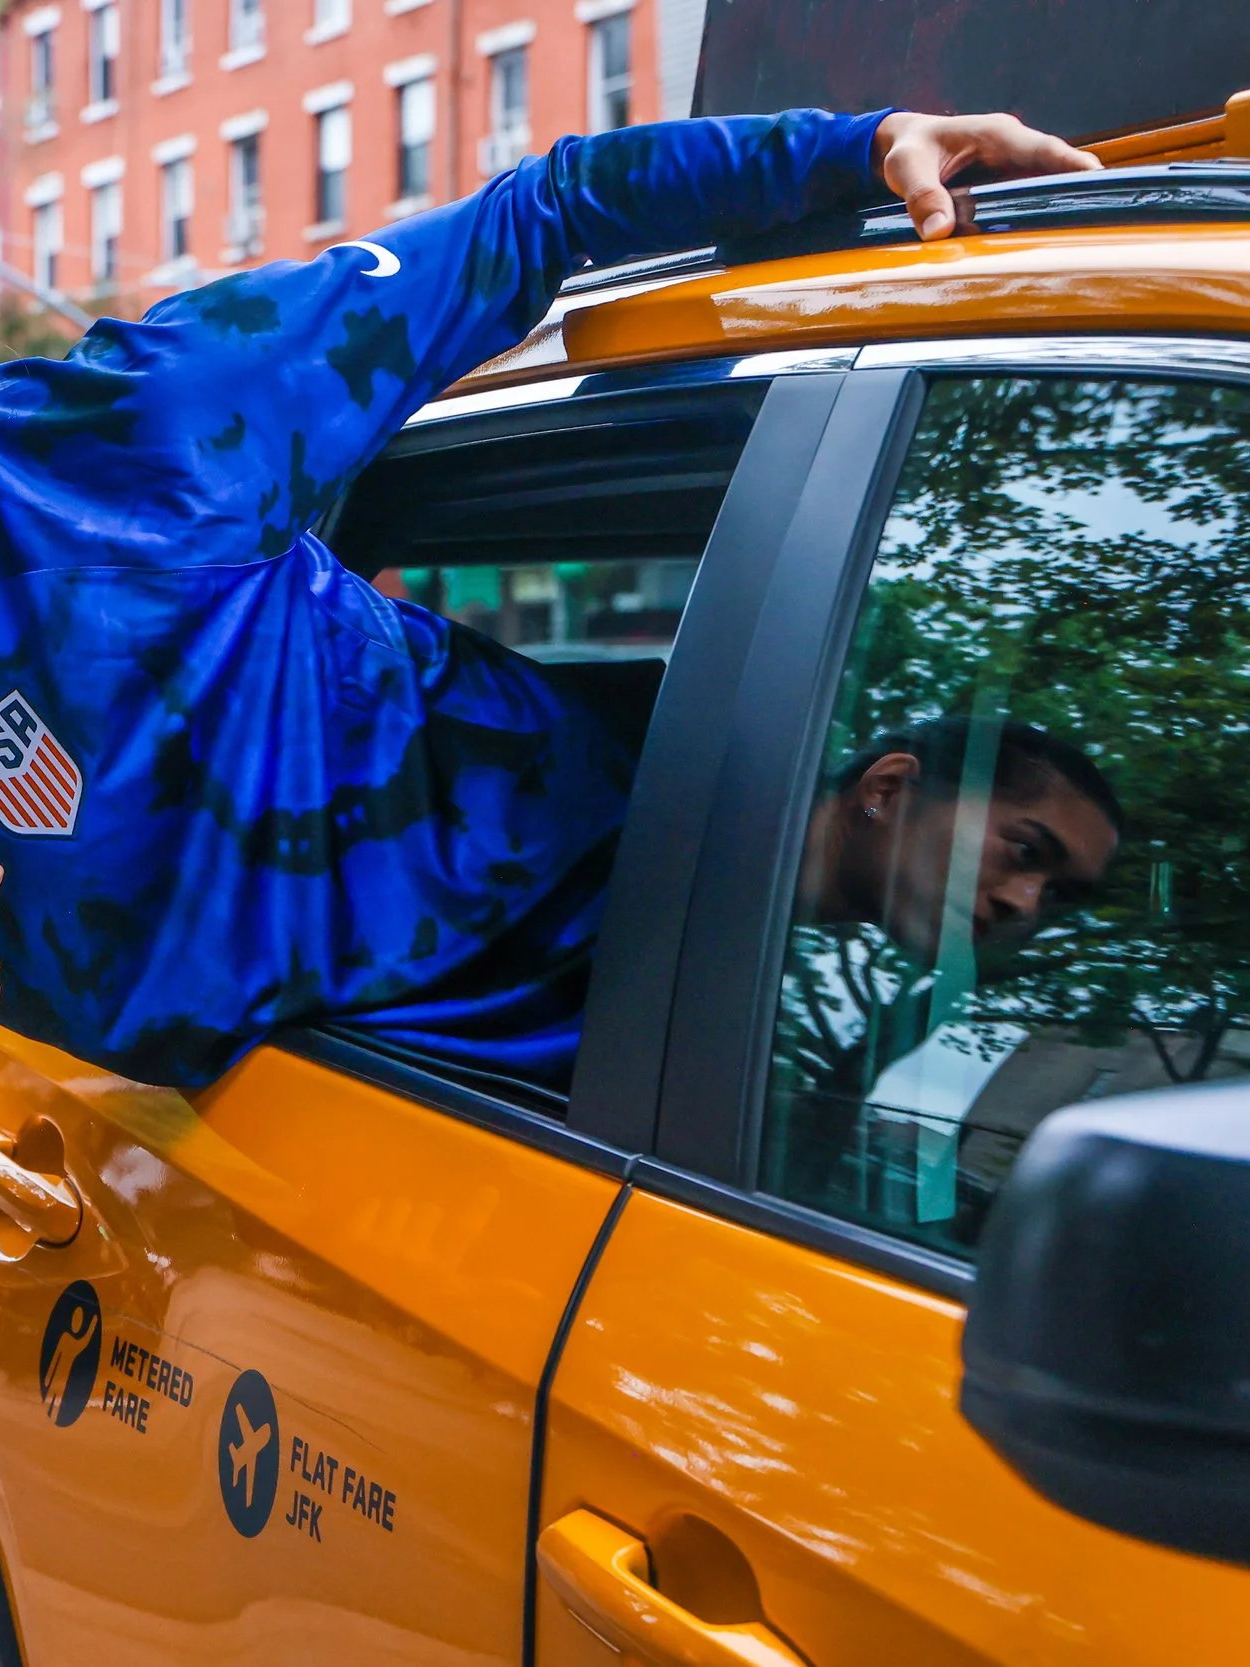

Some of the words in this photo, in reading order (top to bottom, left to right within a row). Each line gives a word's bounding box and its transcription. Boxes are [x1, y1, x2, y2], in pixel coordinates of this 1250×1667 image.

[110, 1335, 194, 1408] METERED
[102, 1380, 150, 1435] FARE
[290, 1435, 339, 1495] FLAT
[342, 1466, 396, 1532] FARE
[285, 1490, 323, 1543] JFK
